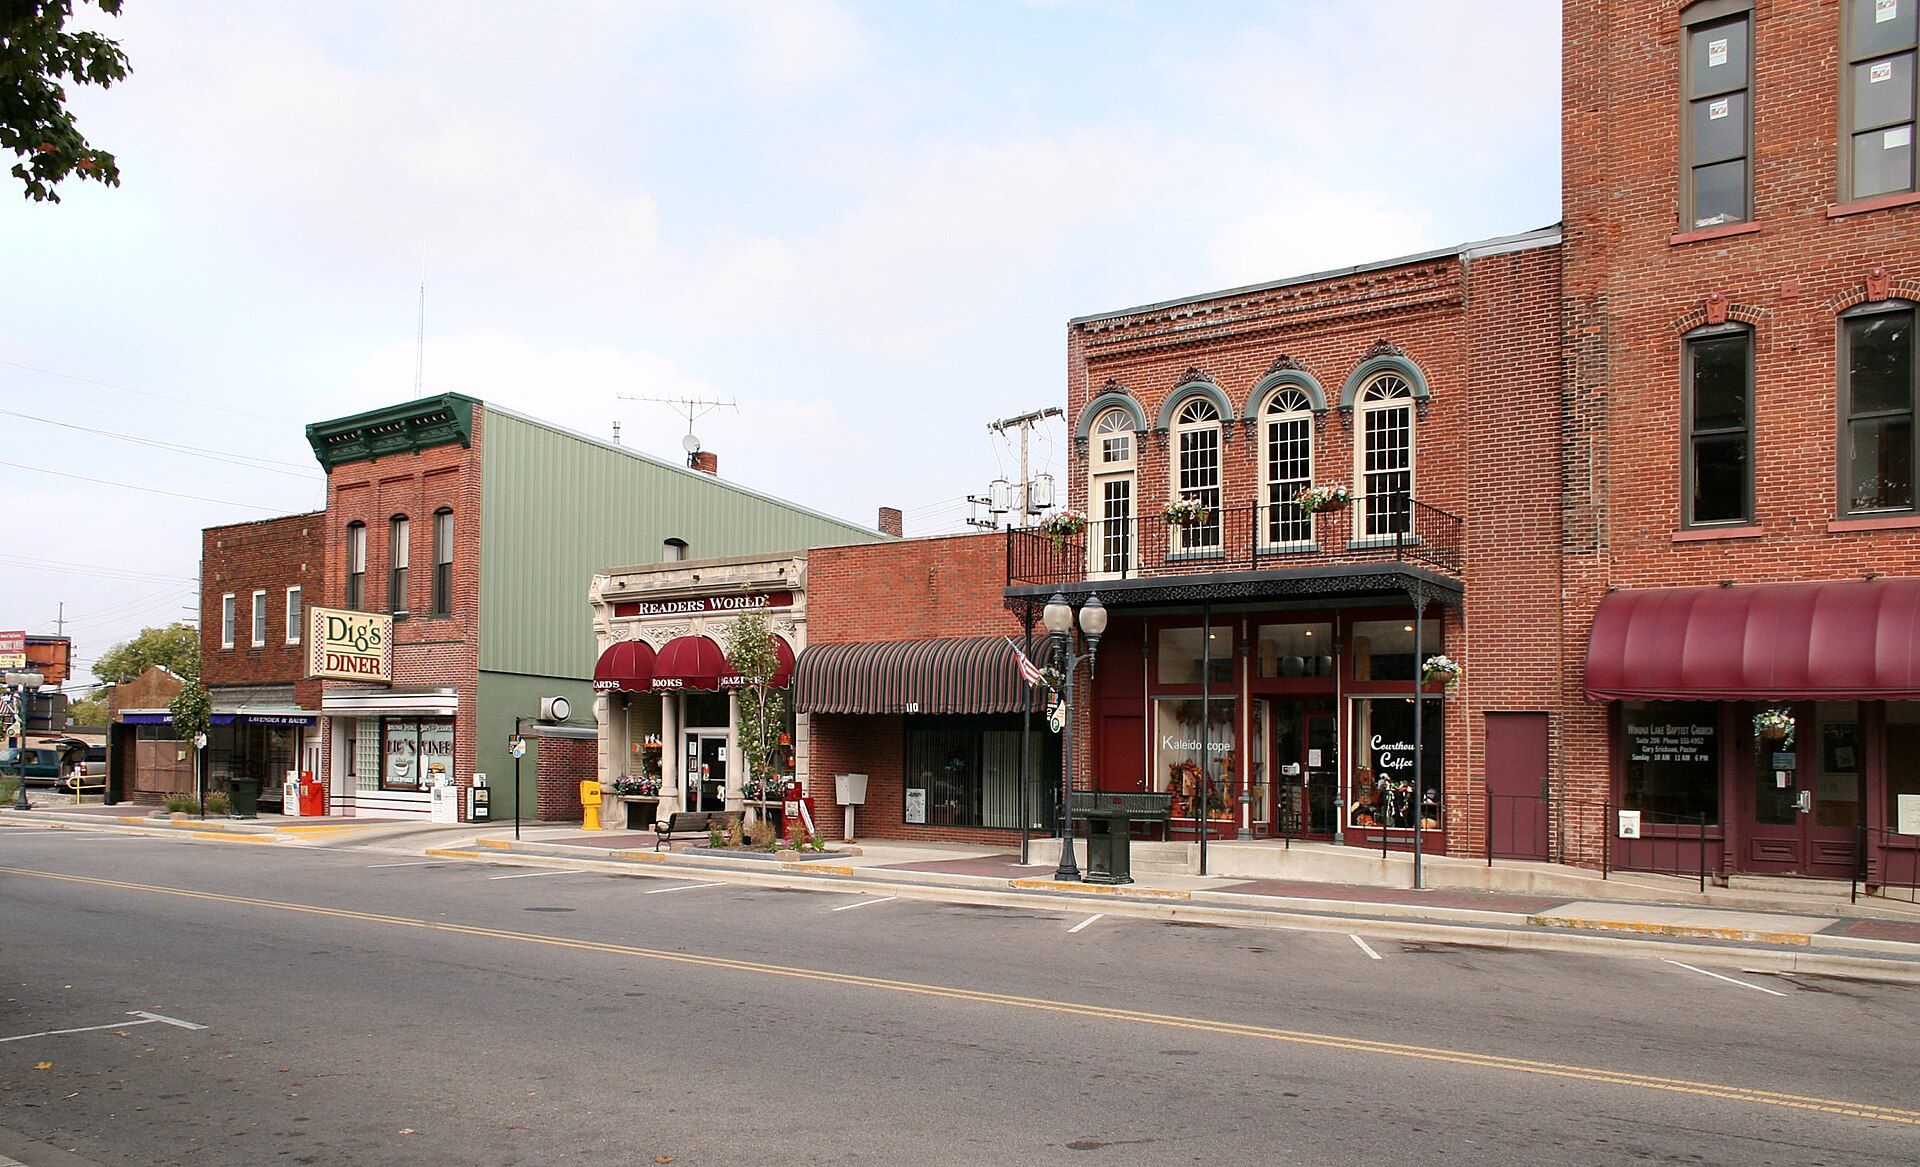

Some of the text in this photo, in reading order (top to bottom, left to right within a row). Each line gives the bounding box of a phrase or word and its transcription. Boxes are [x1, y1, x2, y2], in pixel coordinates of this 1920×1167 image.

[638, 596, 765, 615] READERS WORLD
[326, 616, 381, 652] Dig's
[325, 653, 381, 675] DINER
[652, 678, 683, 687] BOOKS
[906, 702, 919, 713] 110
[1162, 735, 1230, 753] Kaleidocope
[1370, 734, 1424, 751] Courthou
[1379, 751, 1414, 770] Coffee
